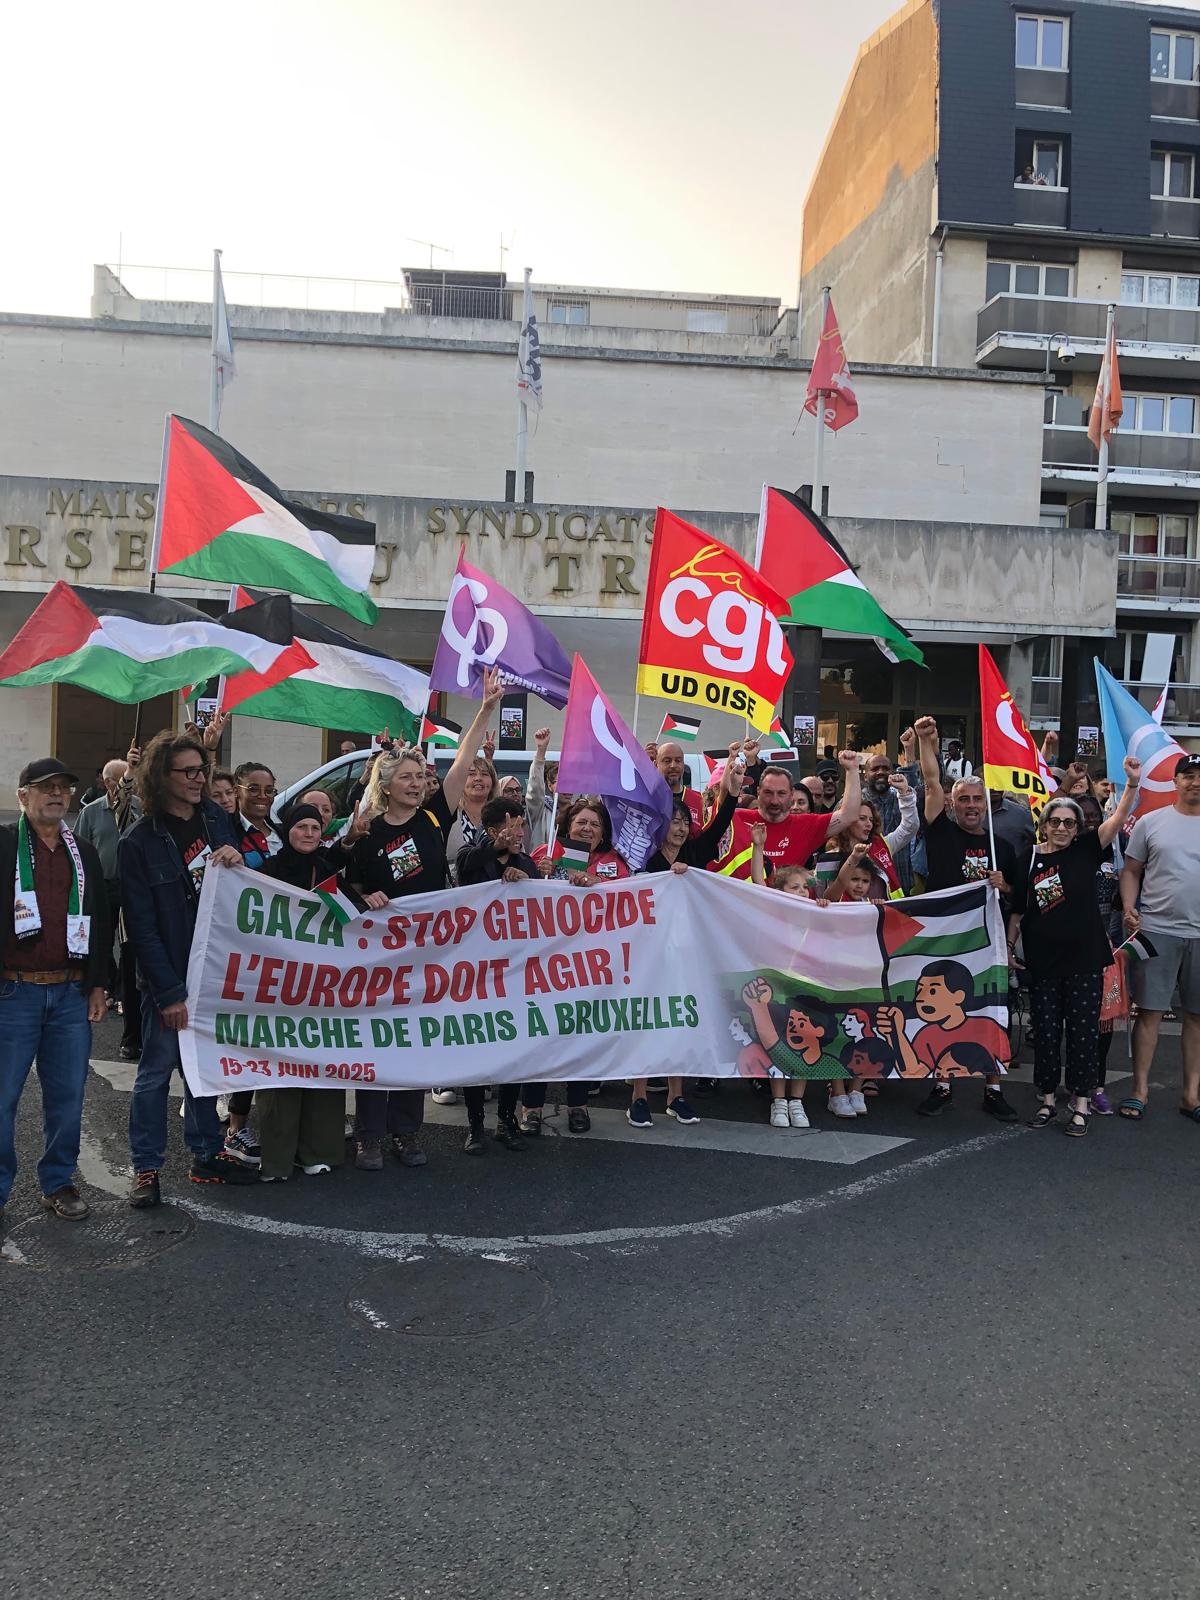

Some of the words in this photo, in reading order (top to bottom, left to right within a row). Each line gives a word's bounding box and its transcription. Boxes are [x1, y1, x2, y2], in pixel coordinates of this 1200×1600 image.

[46, 487, 155, 520] MAIS
[545, 552, 640, 594] TR
[659, 576, 787, 676] cgt
[661, 673, 698, 698] UD
[705, 682, 757, 719] OISE
[1012, 770, 1046, 795] UD
[237, 887, 345, 947] GAZA
[382, 906, 477, 950] STOP
[483, 888, 656, 941] GENOCIDE
[221, 952, 413, 1008] L'EUROPE
[422, 958, 509, 1003] DOIT
[524, 948, 613, 995] AGIR
[215, 1013, 363, 1049] MARCHE
[370, 1017, 412, 1048] DE
[419, 1010, 517, 1047] PARIS
[526, 1001, 549, 1037] À
[554, 994, 699, 1036] BRUXELLES
[278, 1061, 319, 1079] JUIN
[325, 1062, 375, 1083] 2025
